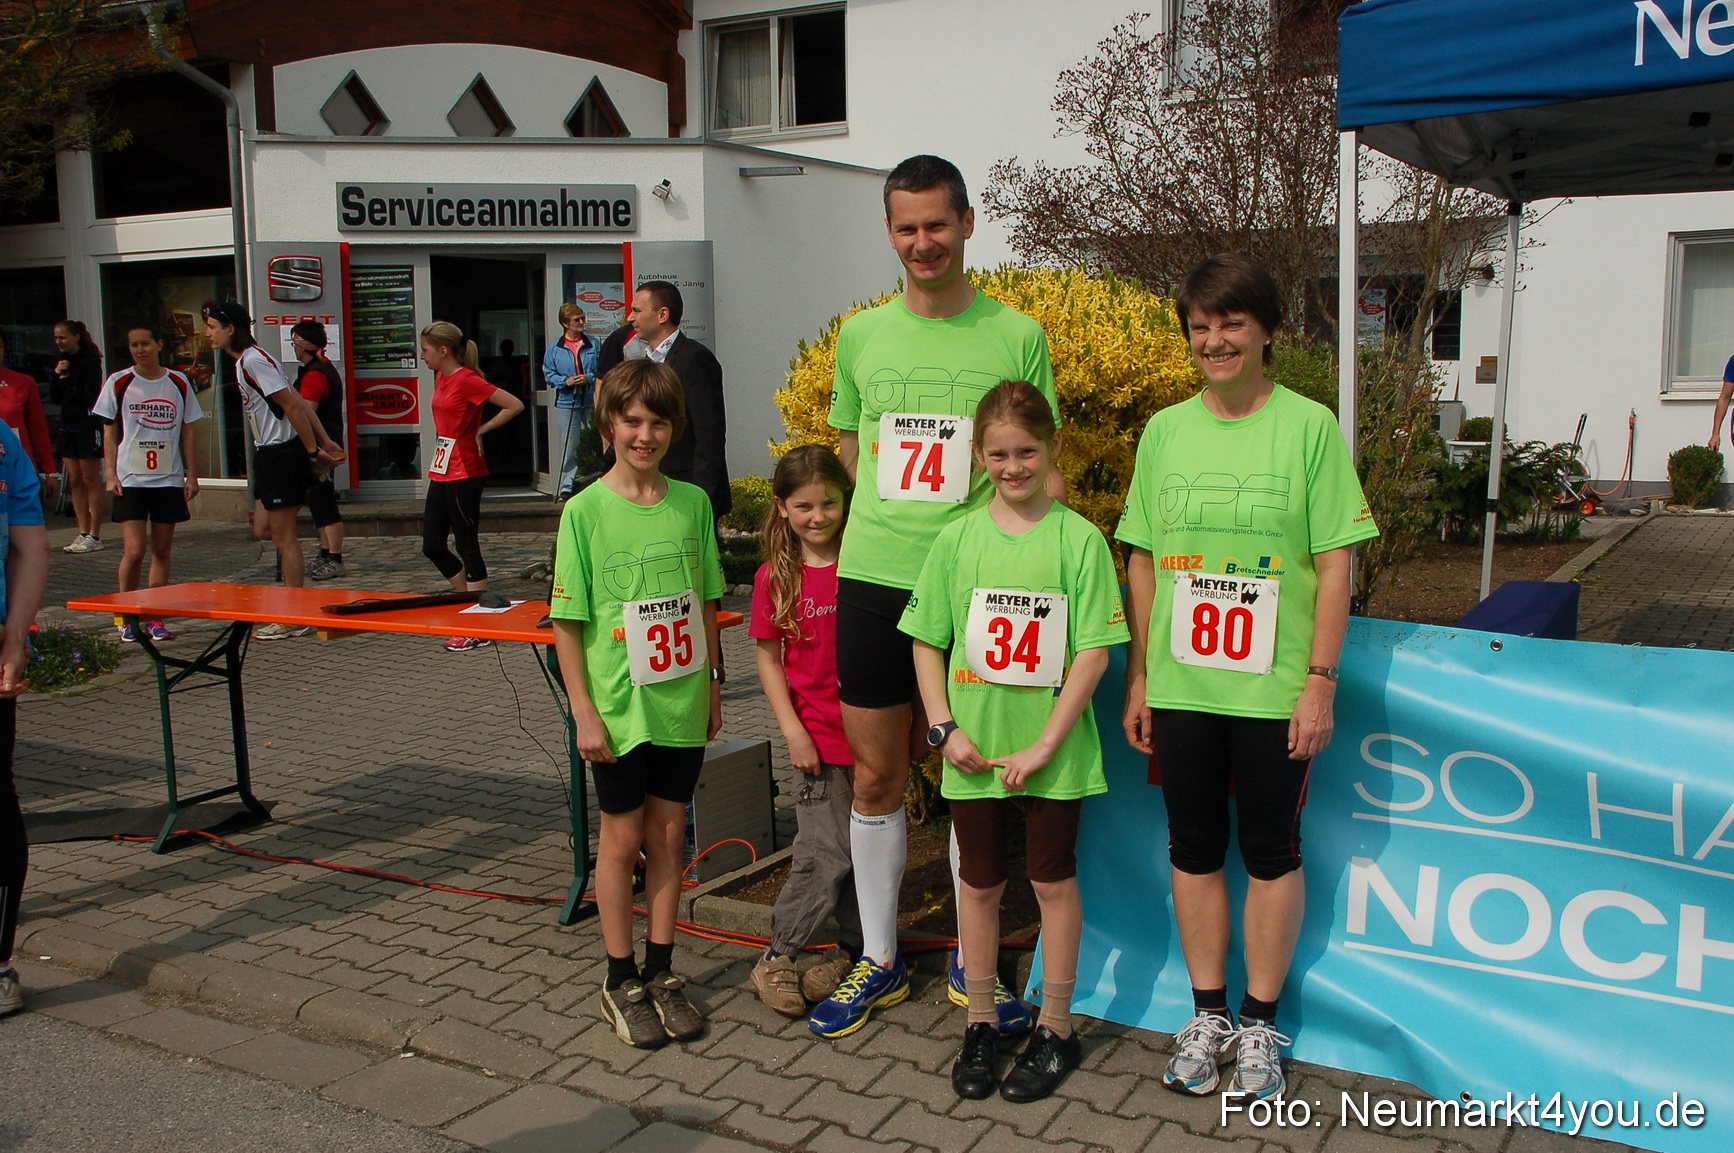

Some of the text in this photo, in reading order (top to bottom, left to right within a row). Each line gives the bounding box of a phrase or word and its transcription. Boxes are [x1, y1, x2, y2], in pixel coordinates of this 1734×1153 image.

[341, 186, 631, 227] Serviceannahme
[263, 315, 336, 326] SEAT
[356, 392, 401, 401] ERHART
[129, 403, 171, 412] GERHART
[895, 418, 936, 429] MEYER
[895, 428, 937, 437] WERBUNG
[146, 450, 158, 470] 8
[900, 441, 945, 492] 74
[1160, 555, 1204, 570] MERZ
[1191, 578, 1238, 593] MEYER
[986, 593, 1031, 607] MEYER
[1191, 588, 1238, 601] WERBUNG
[639, 599, 679, 614] MEYER
[985, 604, 1031, 616] WERBUNG
[639, 610, 680, 621] WERBUNG
[1192, 602, 1254, 661] 80
[647, 618, 693, 673] 35
[985, 616, 1041, 673] 34
[1352, 732, 1534, 824] SO
